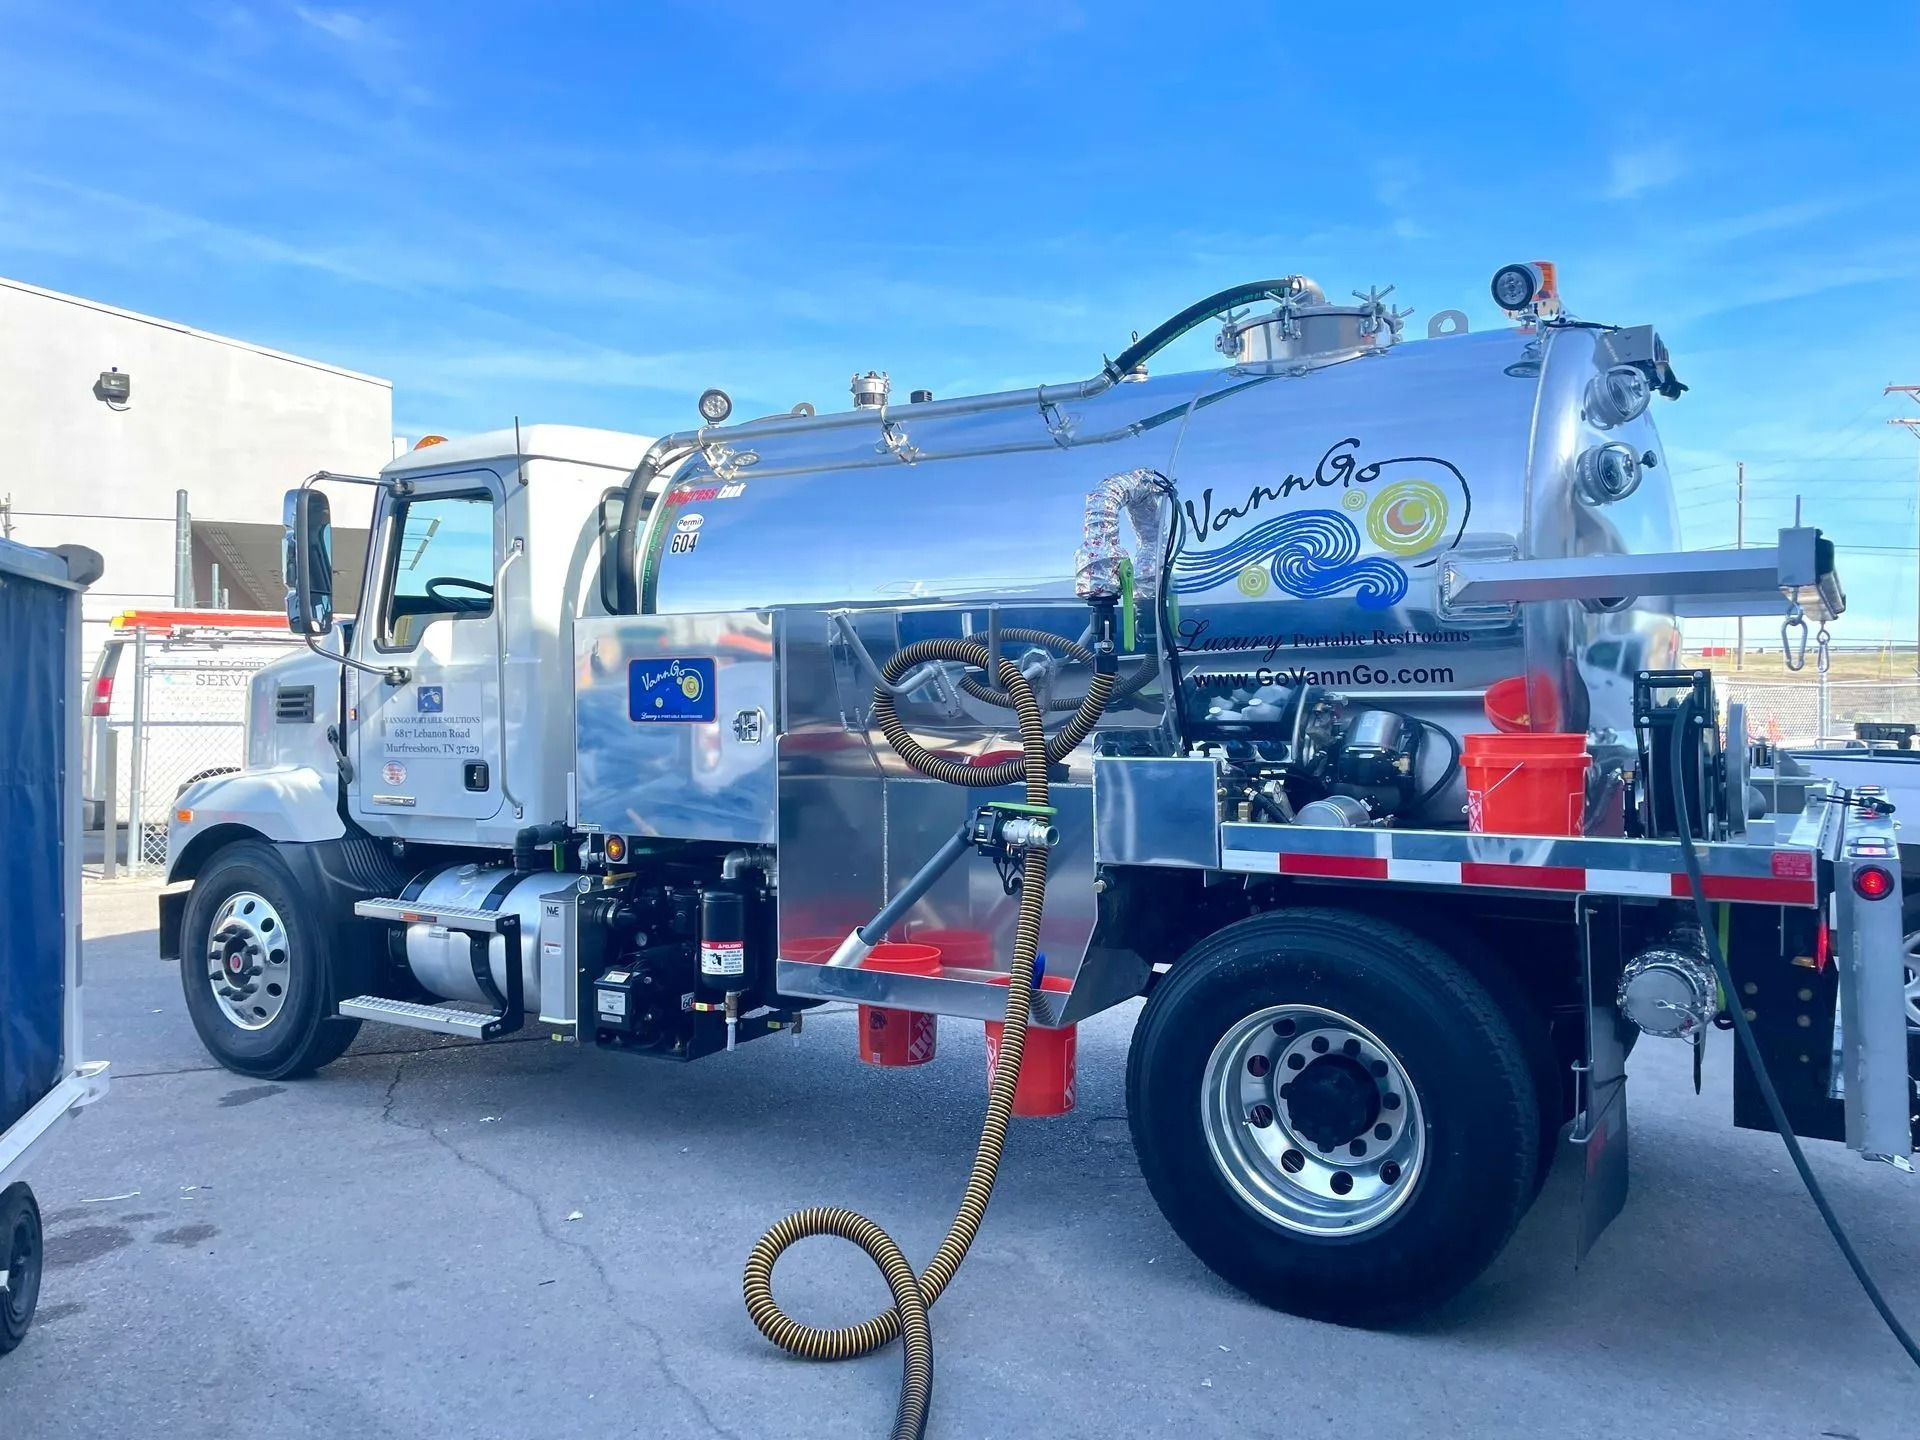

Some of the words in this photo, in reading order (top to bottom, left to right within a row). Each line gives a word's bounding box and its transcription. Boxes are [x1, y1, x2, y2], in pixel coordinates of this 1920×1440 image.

[1185, 438, 1382, 542] VannGo
[678, 518, 703, 527] Permit
[671, 534, 698, 554] 604
[1175, 619, 1284, 662] Luxury
[1292, 630, 1366, 649] Portable
[1372, 628, 1470, 645] Restrooms
[641, 659, 686, 691] VannGo
[1192, 664, 1454, 688] www.GoVannGo.com
[444, 716, 480, 724] SOLUTIONS
[394, 729, 412, 739] 6817
[413, 728, 447, 738] Lebanon
[449, 728, 471, 738] Road
[386, 743, 441, 754] Murfreesboro,
[443, 743, 455, 753] TN
[456, 745, 480, 755] 37129
